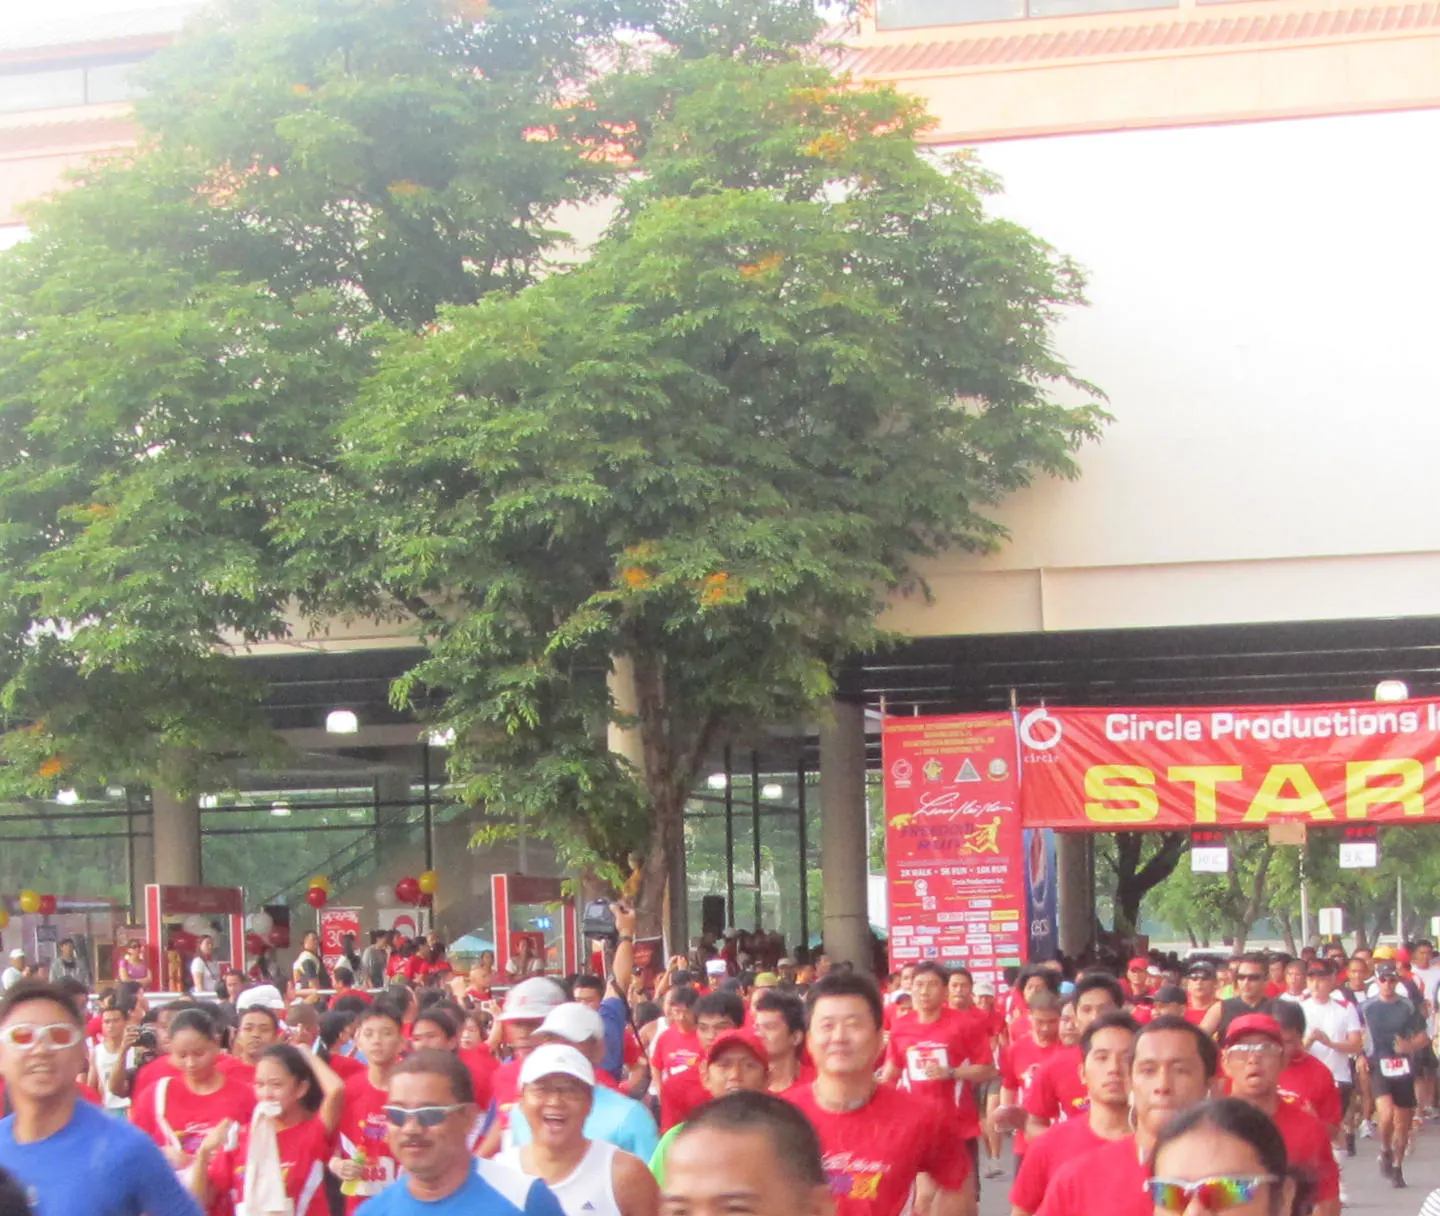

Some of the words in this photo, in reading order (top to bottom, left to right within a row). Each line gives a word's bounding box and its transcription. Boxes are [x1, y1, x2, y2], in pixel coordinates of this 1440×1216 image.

[1105, 713, 1202, 741] Circle
[1211, 706, 1419, 741] Productions
[1023, 752, 1060, 764] circle
